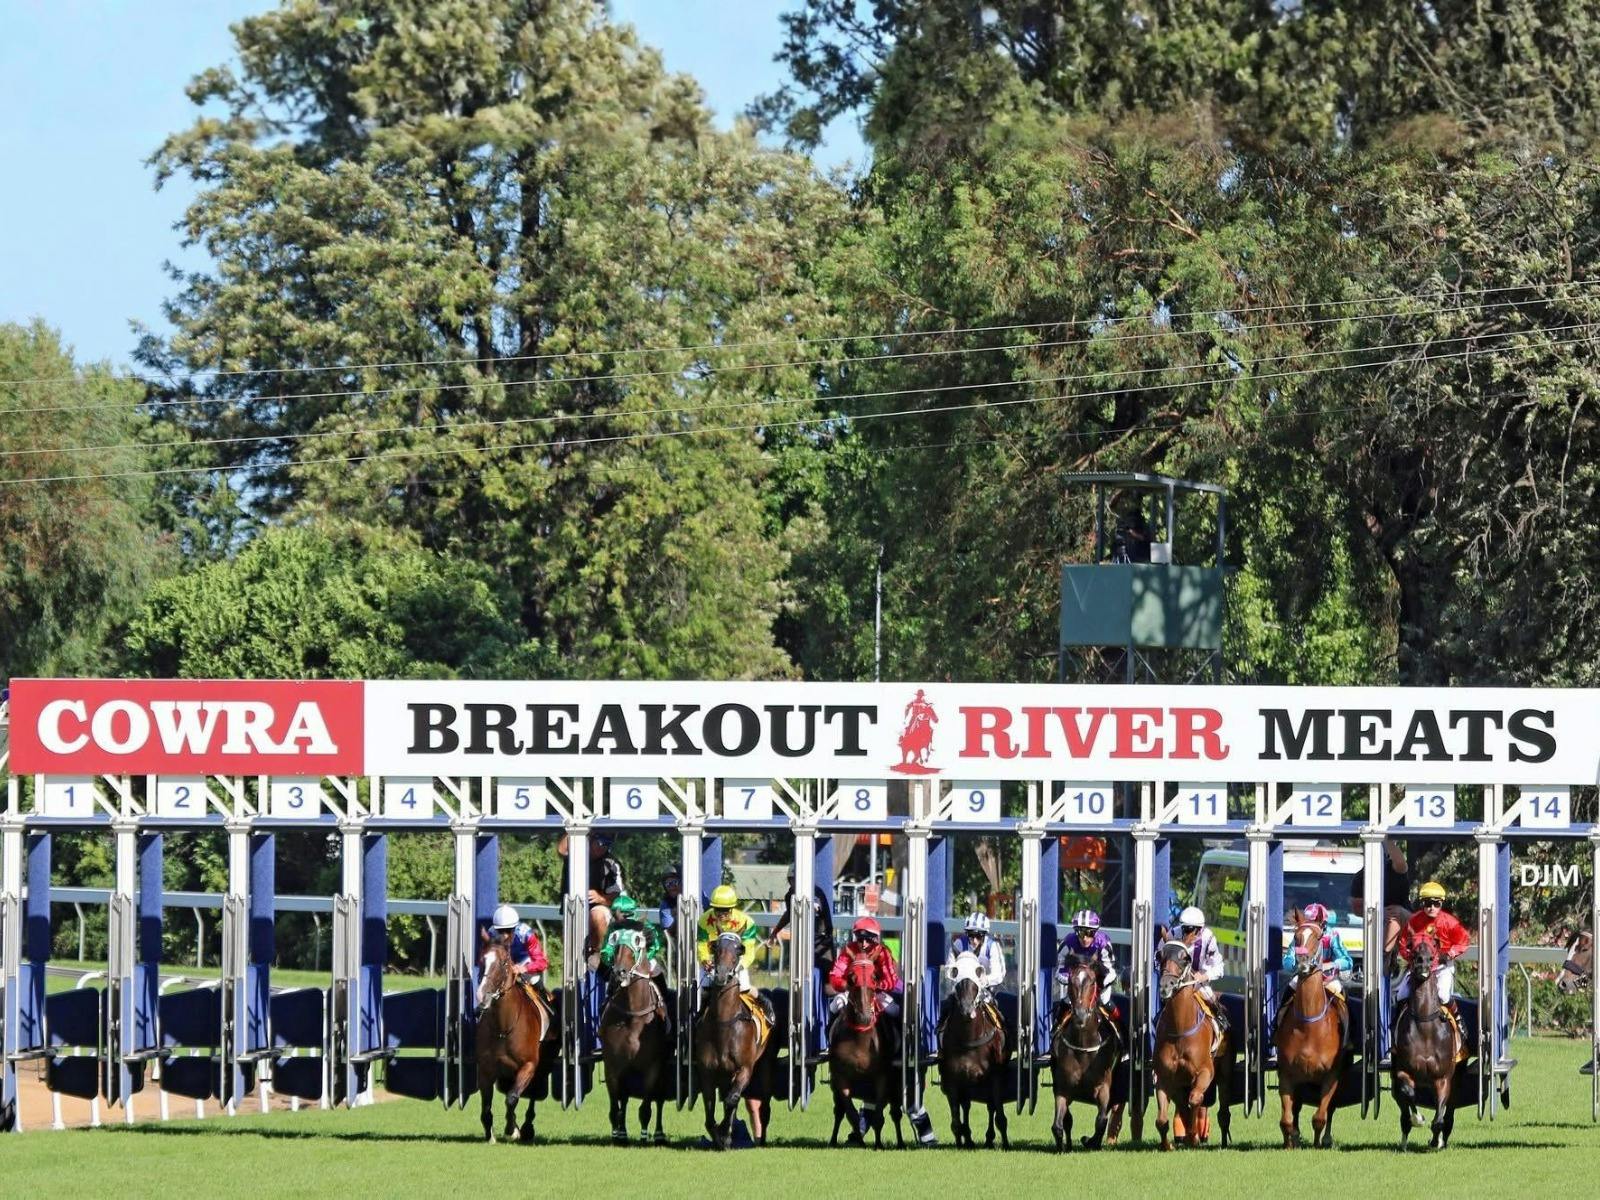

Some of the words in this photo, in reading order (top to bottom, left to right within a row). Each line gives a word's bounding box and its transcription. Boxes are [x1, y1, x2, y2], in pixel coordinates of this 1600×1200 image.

[37, 699, 338, 754] COWRA
[407, 702, 878, 758] BREAKOUT
[959, 706, 1230, 760] RIVER
[1258, 708, 1557, 764] MEATS
[65, 786, 76, 808] 1
[175, 786, 190, 808] 2
[289, 786, 304, 809] 3
[400, 787, 417, 809] 4
[515, 787, 531, 810] 5
[626, 787, 643, 810] 6
[741, 788, 757, 809] 7
[853, 788, 871, 811] 8
[968, 790, 985, 813] 9
[1074, 791, 1105, 815] 10
[1189, 793, 1218, 816] 11
[1301, 793, 1333, 817] 12
[1415, 795, 1445, 818] 13
[1530, 797, 1561, 818] 14
